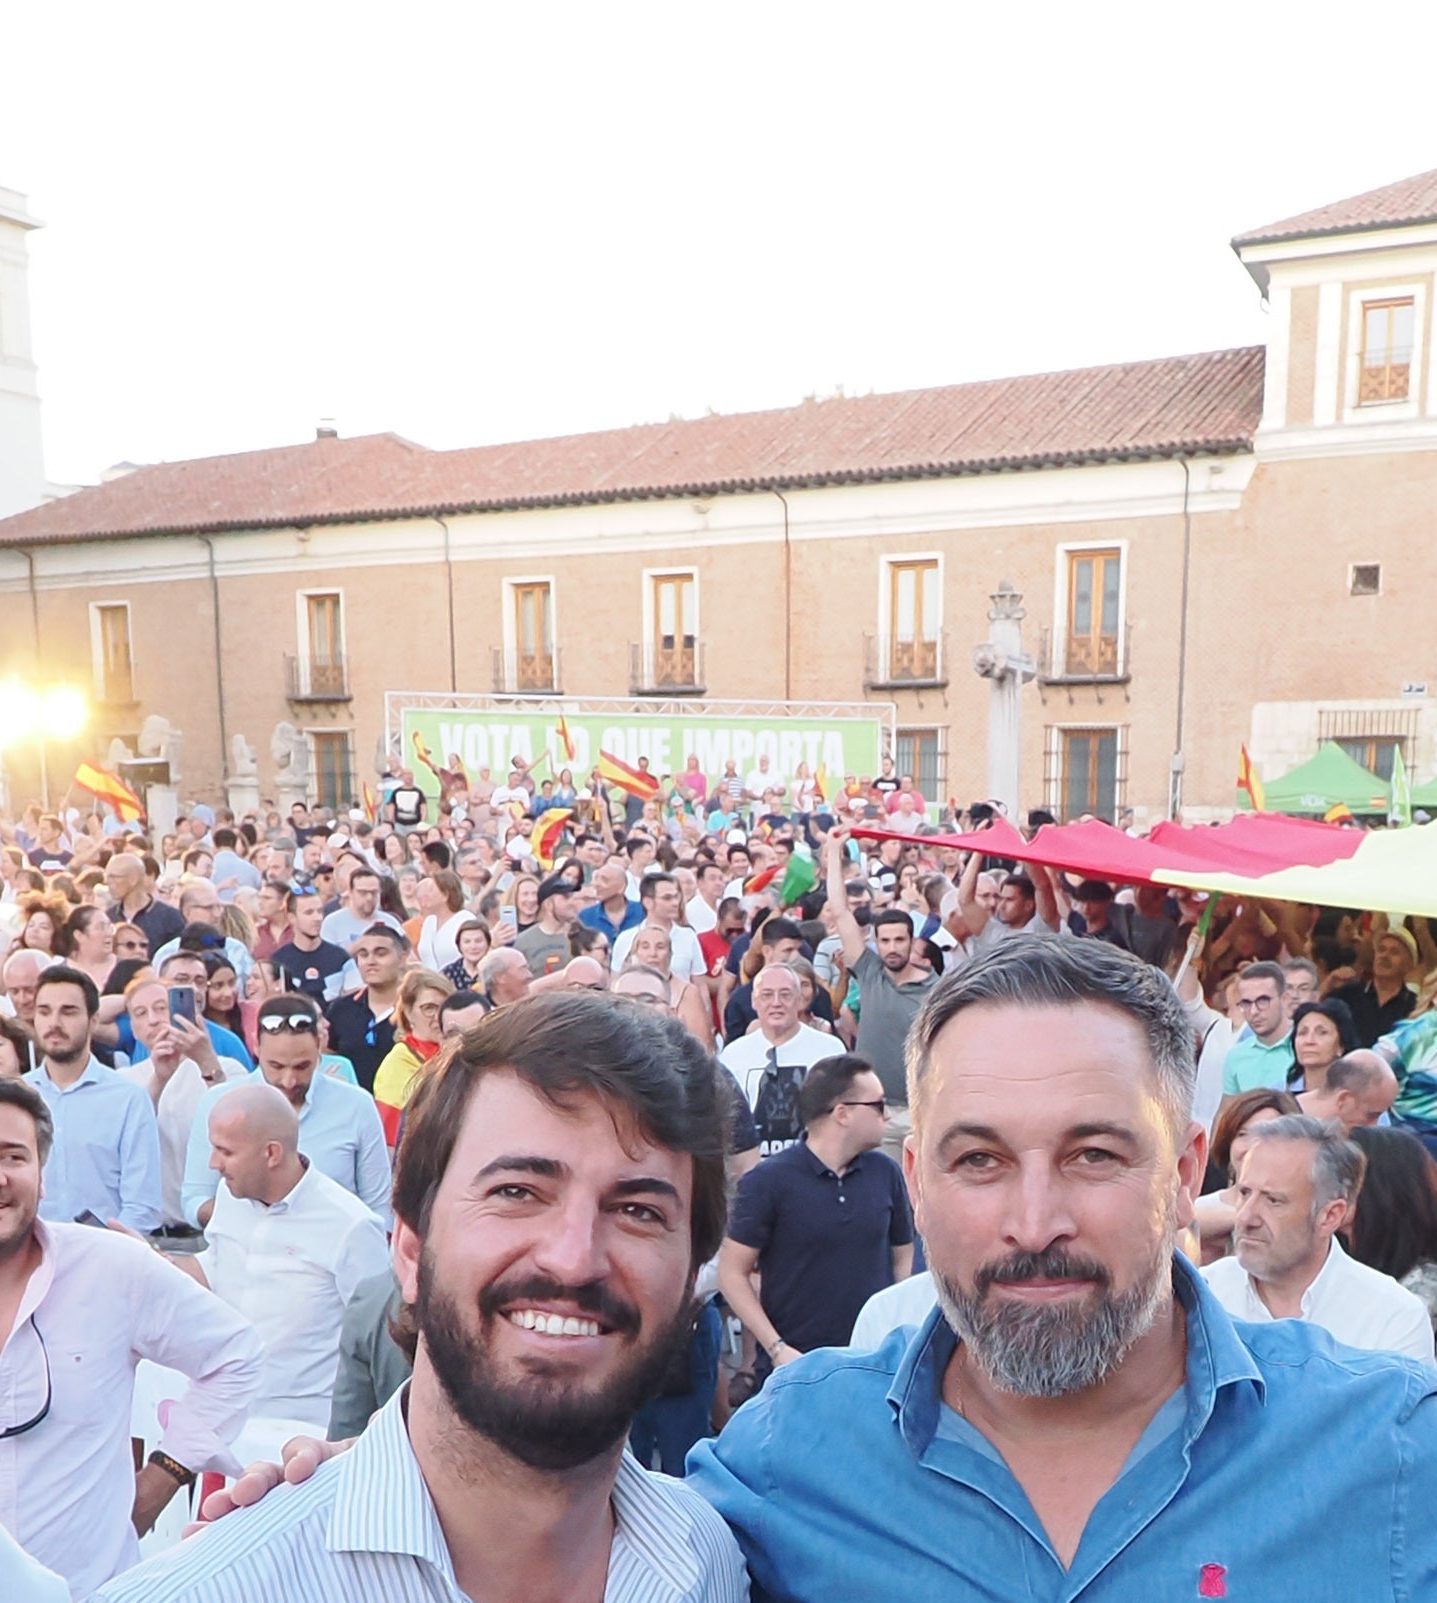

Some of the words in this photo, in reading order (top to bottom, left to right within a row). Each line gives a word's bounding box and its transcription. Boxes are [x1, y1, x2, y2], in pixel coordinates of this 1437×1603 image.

[439, 722, 532, 773] VOTA
[545, 724, 590, 773] LO
[602, 725, 672, 774] QUE
[682, 727, 845, 778] IMPORTA
